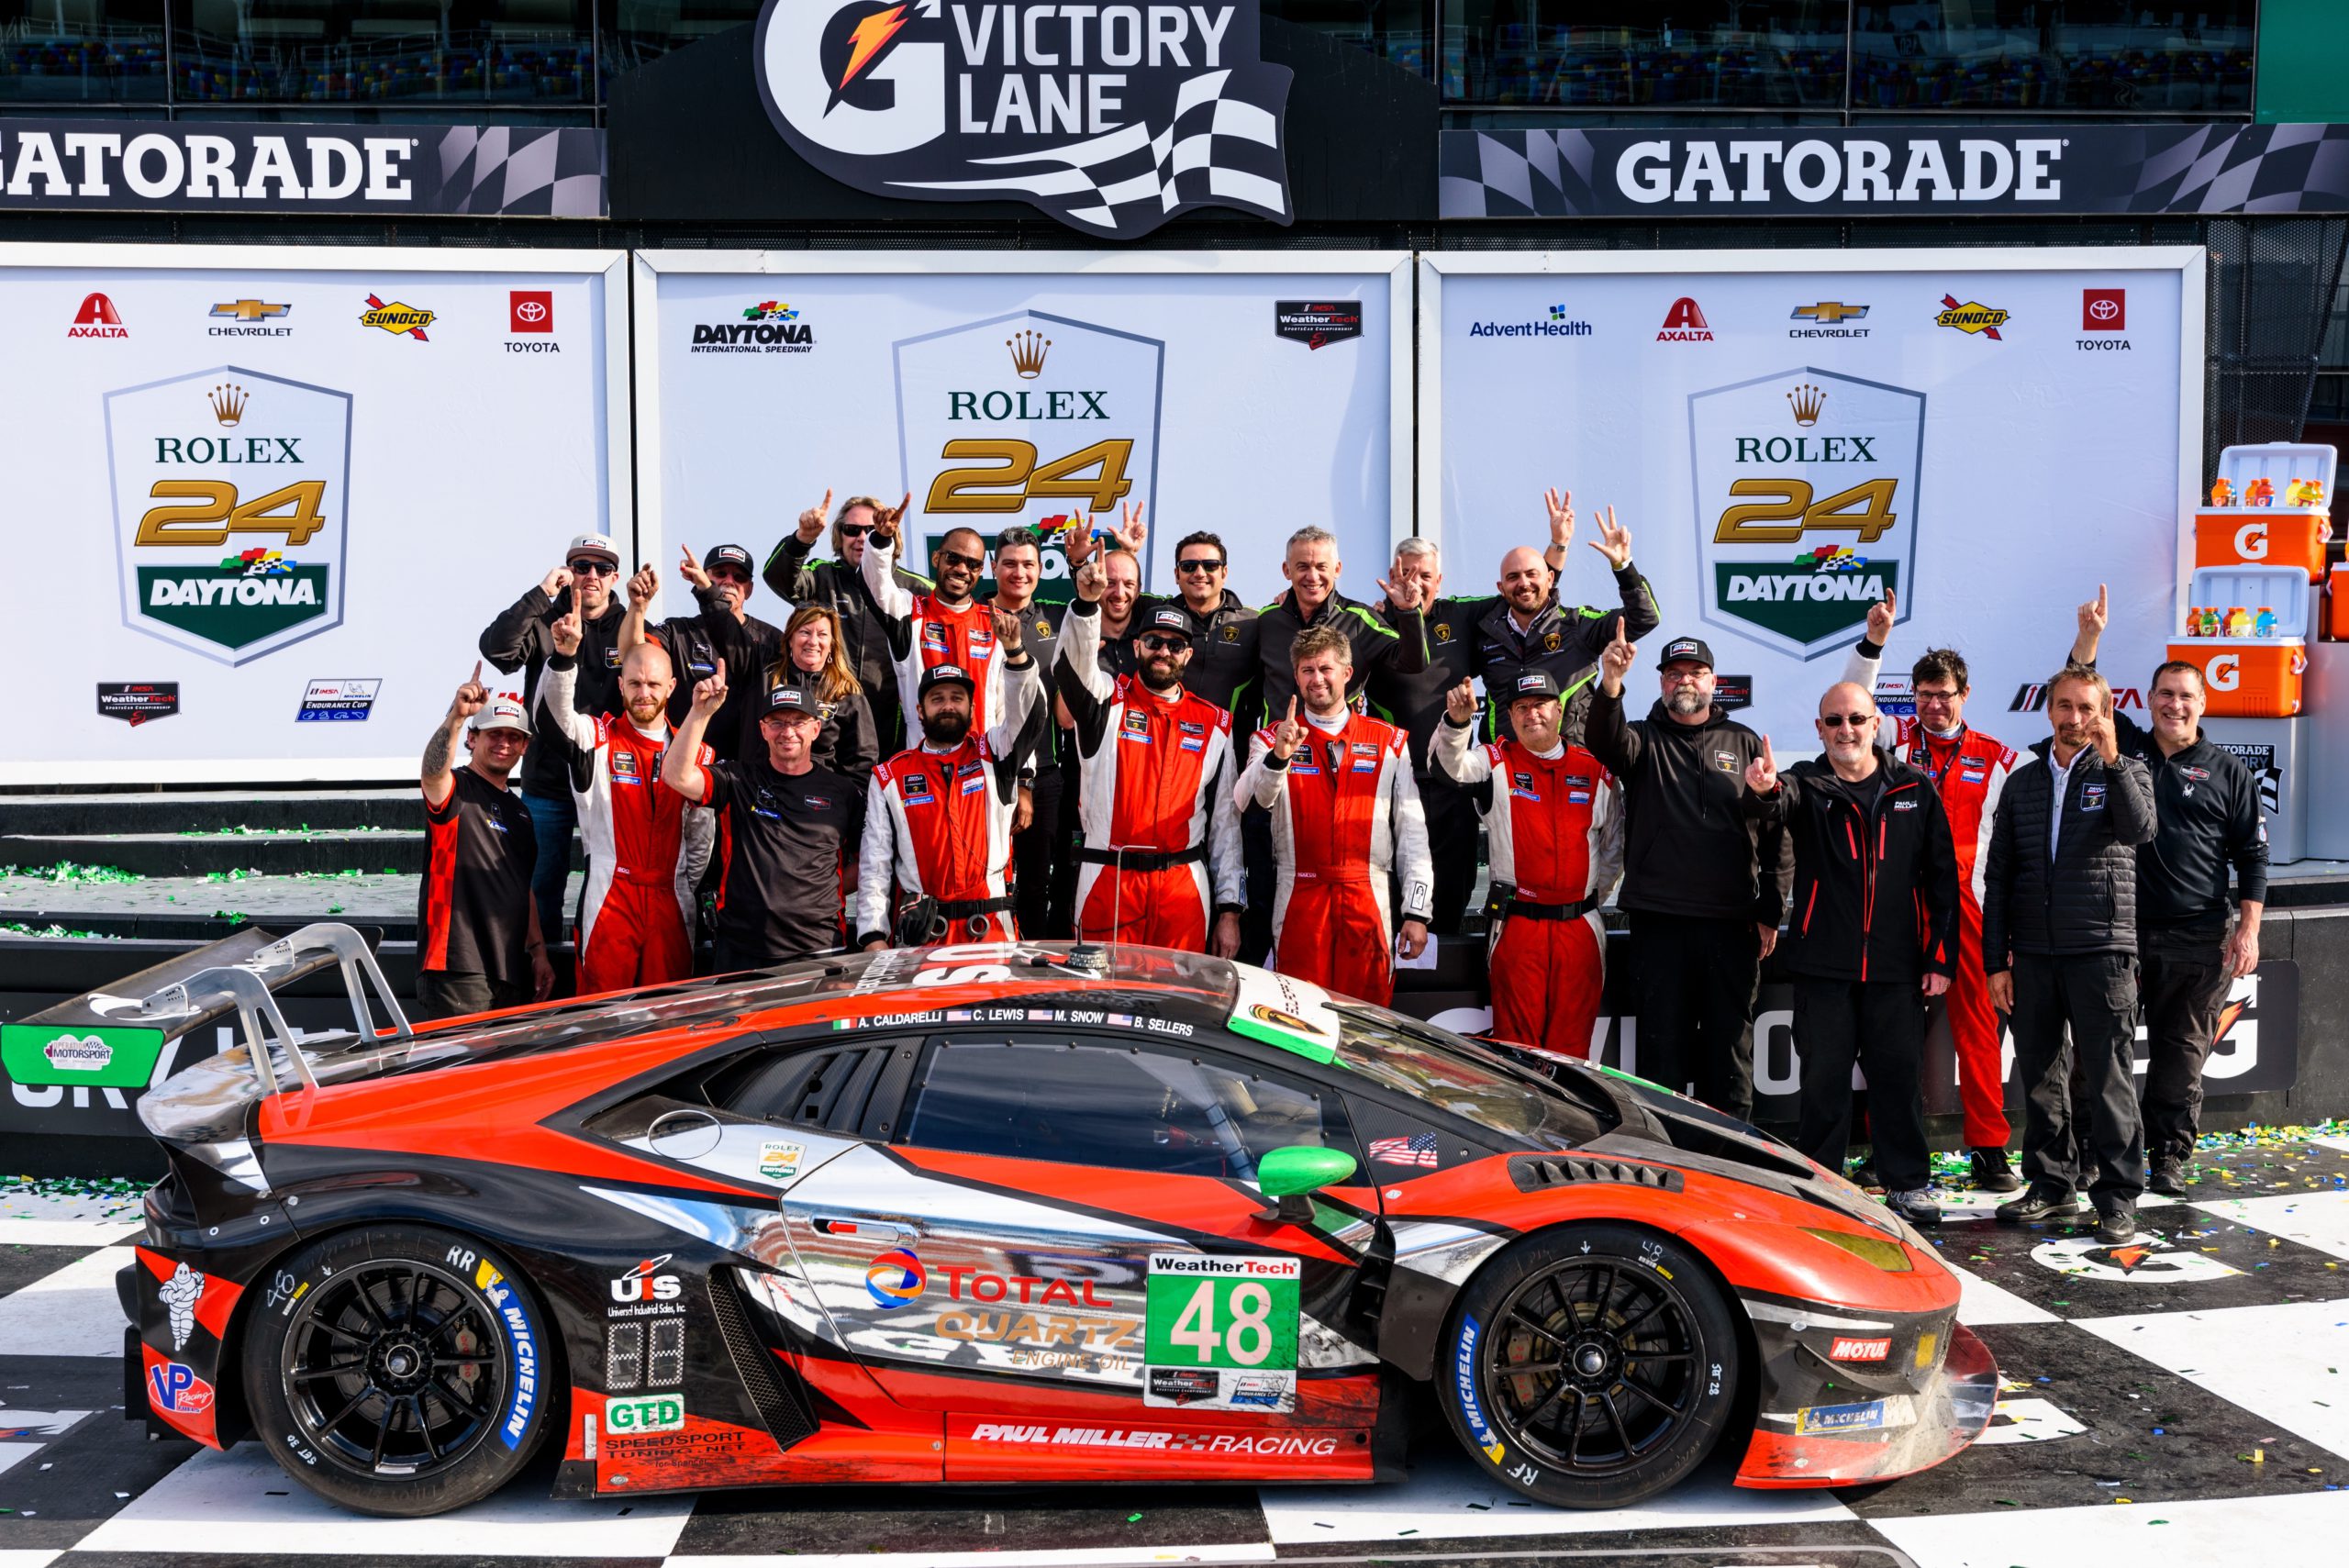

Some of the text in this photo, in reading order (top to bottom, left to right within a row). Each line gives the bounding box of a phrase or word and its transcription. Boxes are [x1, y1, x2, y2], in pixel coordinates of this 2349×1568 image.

[951, 5, 1236, 68] VICTORY
[764, 0, 945, 155] G
[959, 73, 1127, 135] LANE
[0, 132, 412, 200] ATORADE
[1615, 139, 2063, 203] GATORADE
[365, 313, 430, 325] SUNOCO
[1941, 312, 2003, 325] SUNOCO
[67, 328, 129, 339] AXALTA
[208, 328, 293, 337] CHEVROLET
[693, 324, 813, 344] DAYTONA
[1655, 331, 1714, 341] AXALTA
[1789, 329, 1871, 338] CHEVROLET
[504, 342, 561, 352] TOYOTA
[2076, 340, 2132, 350] TOYOTA
[947, 390, 1110, 421] ROLEX
[155, 437, 304, 463] ROLEX
[1735, 437, 1878, 462] ROLEX
[923, 439, 1134, 514] 24
[134, 480, 327, 547] 24
[1714, 478, 1898, 543] 24
[2234, 523, 2268, 560] G
[149, 578, 317, 606] DAYTONA
[1726, 574, 1886, 601] DAYTONA
[2205, 654, 2240, 691] G
[306, 701, 351, 709] ENDURANCE
[2221, 746, 2269, 755] TORADE
[858, 1011, 942, 1029] A. CALDARELLI
[973, 1009, 1024, 1021] C. LEWIS
[1055, 1010, 1104, 1024] M. SNOW
[1134, 1017, 1193, 1037] B. SELLERS
[53, 1049, 111, 1059] MOTORSPORT
[763, 1151, 798, 1162] 24
[445, 1245, 476, 1272] RR
[1155, 1257, 1296, 1274] WeatherTech
[937, 1266, 1113, 1307] TOTAL
[608, 1305, 633, 1317] Universal
[634, 1303, 658, 1316] Industrial
[676, 1303, 686, 1312] Inc.
[935, 1310, 1139, 1347] QUARTZ
[1169, 1281, 1273, 1366] 48
[1012, 1350, 1131, 1371] ENGINE OIL
[1832, 1340, 1888, 1359] MOTUL
[504, 1307, 535, 1438] MICHELIN
[1153, 1379, 1217, 1388] WeatherTech
[1457, 1325, 1485, 1429] MICHELIN
[150, 1362, 195, 1411] VP
[178, 1391, 213, 1406] Racing
[610, 1401, 680, 1428] GTD
[606, 1431, 746, 1450] SPEEDSPORT
[971, 1424, 1336, 1456] PAUL MILLER RACING
